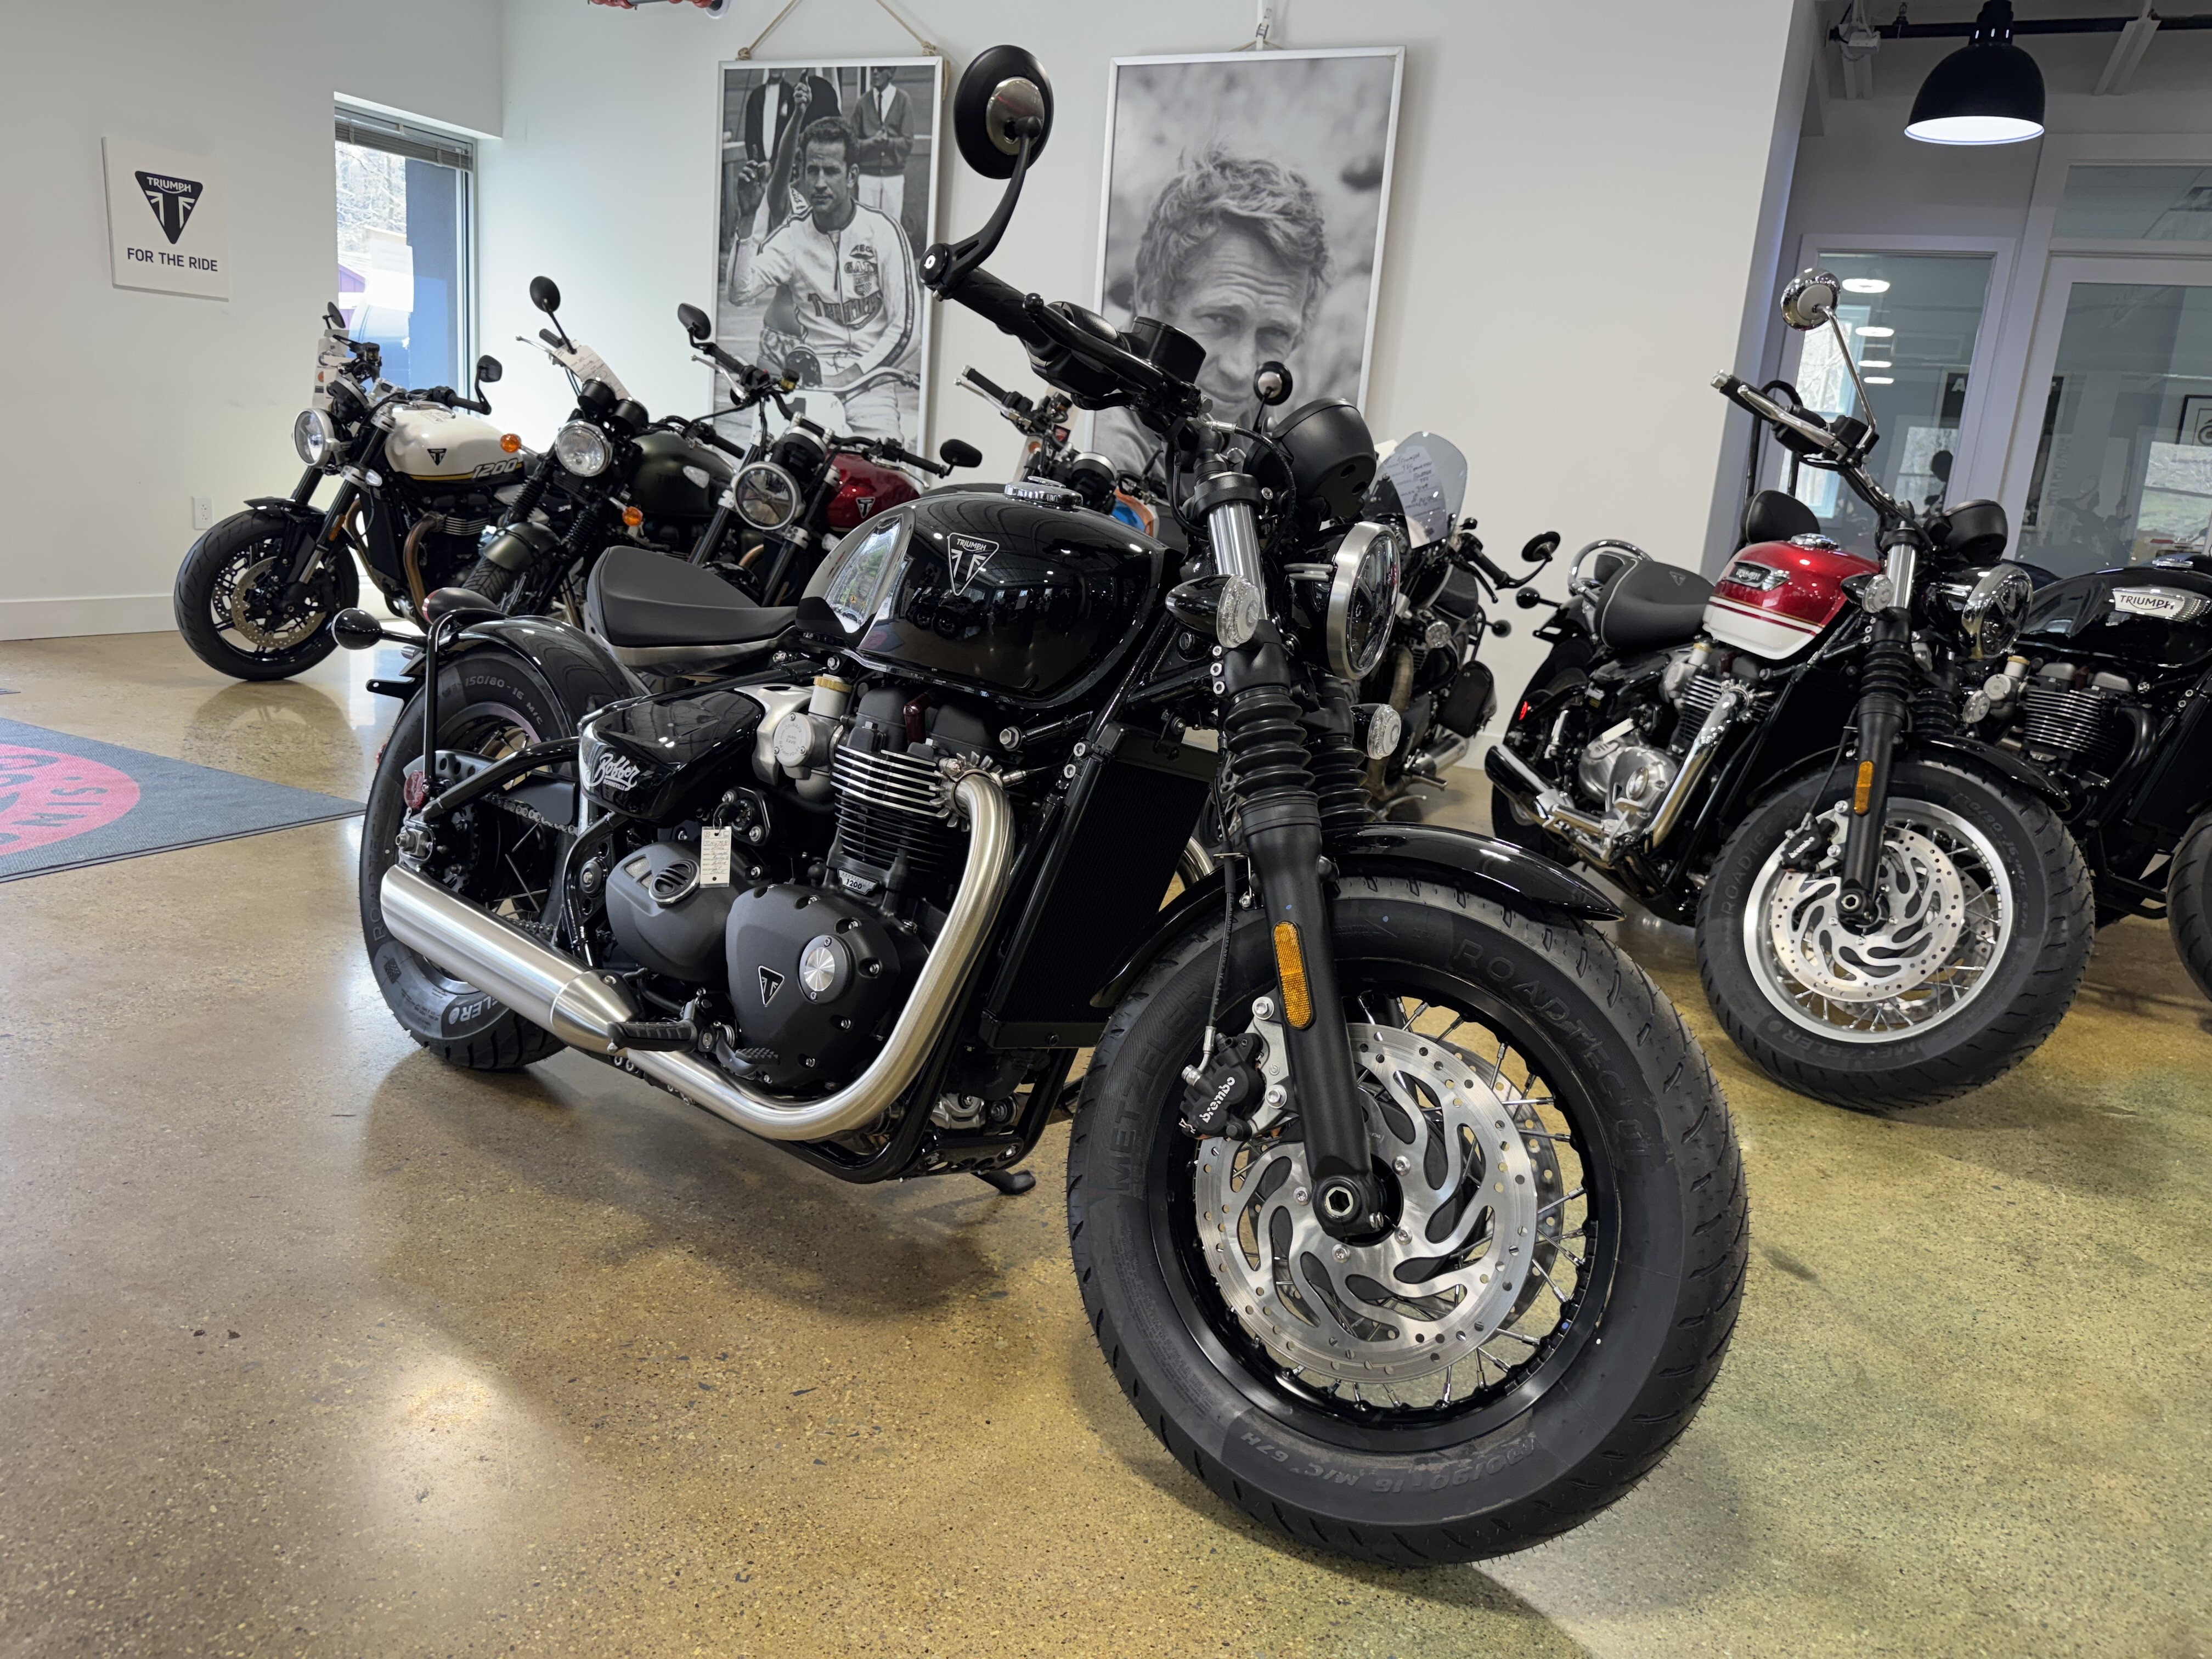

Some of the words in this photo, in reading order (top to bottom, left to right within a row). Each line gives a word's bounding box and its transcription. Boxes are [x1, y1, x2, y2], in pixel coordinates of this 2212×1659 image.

[146, 176, 191, 193] TRIUMPH
[127, 247, 154, 263] FOR
[159, 252, 184, 267] THE
[189, 256, 218, 272] RIDE
[472, 457, 518, 478] 1200
[957, 538, 986, 551] TRIUMPH
[2120, 595, 2174, 610] TRIUMPH
[466, 675, 505, 688] 150/80
[512, 687, 524, 700] 16
[526, 702, 543, 725] M/C
[585, 753, 640, 791] Bobber
[1788, 837, 1815, 859] brembo
[847, 879, 862, 889] 1200
[1454, 939, 1626, 1099] ROADTEC
[1199, 1076, 1235, 1123] brembo
[1240, 1432, 1289, 1463] 67H
